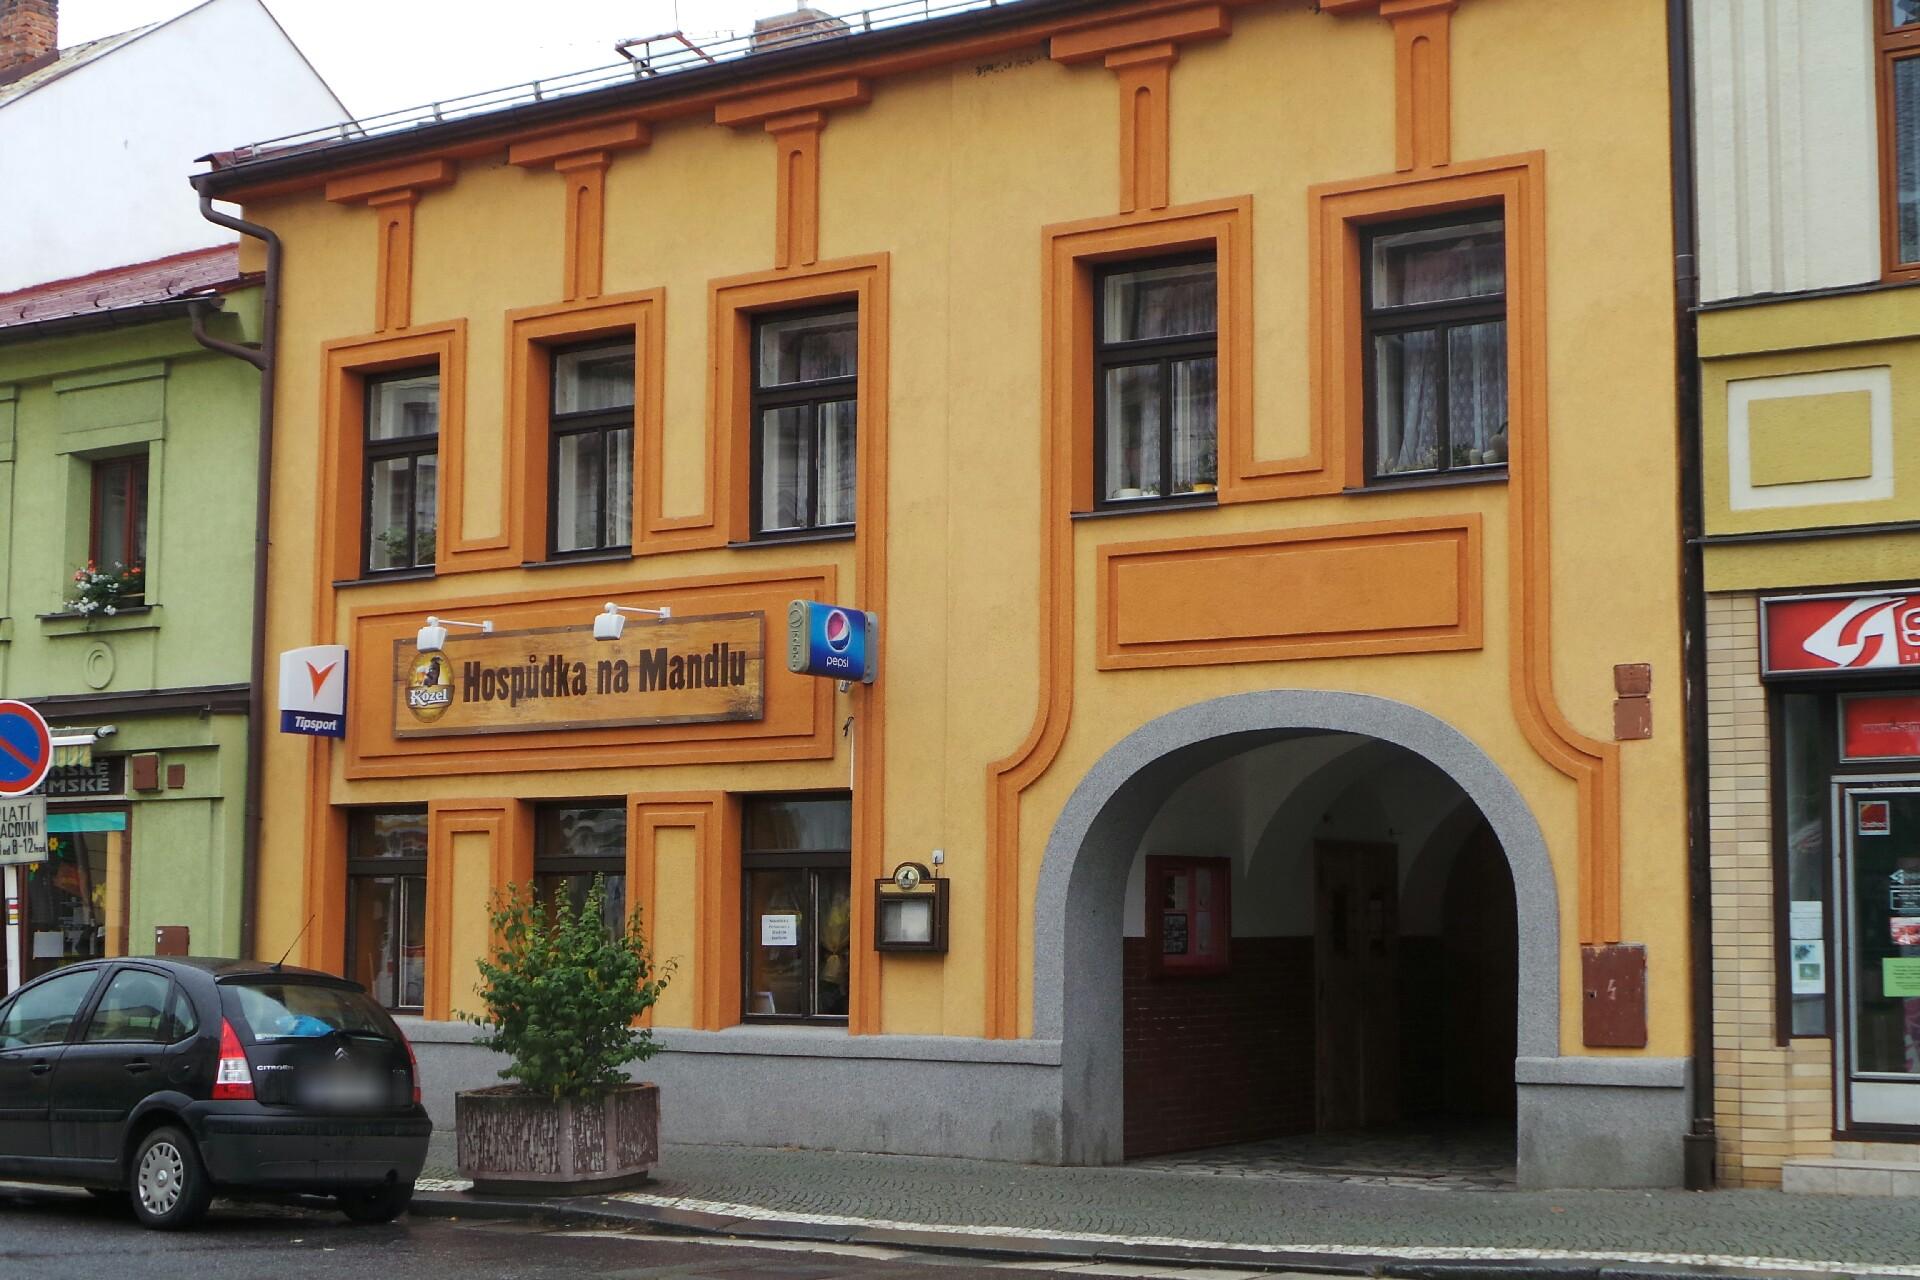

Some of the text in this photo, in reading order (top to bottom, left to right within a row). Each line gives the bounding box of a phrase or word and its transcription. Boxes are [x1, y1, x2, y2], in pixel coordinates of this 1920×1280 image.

[826, 656, 849, 669] pepsi
[463, 654, 587, 708] Hospůdka
[596, 658, 630, 695] na
[638, 642, 746, 693] Mandlu
[410, 688, 449, 706] Kozel
[294, 715, 337, 732] Tipsport
[0, 803, 32, 822] LATÍ
